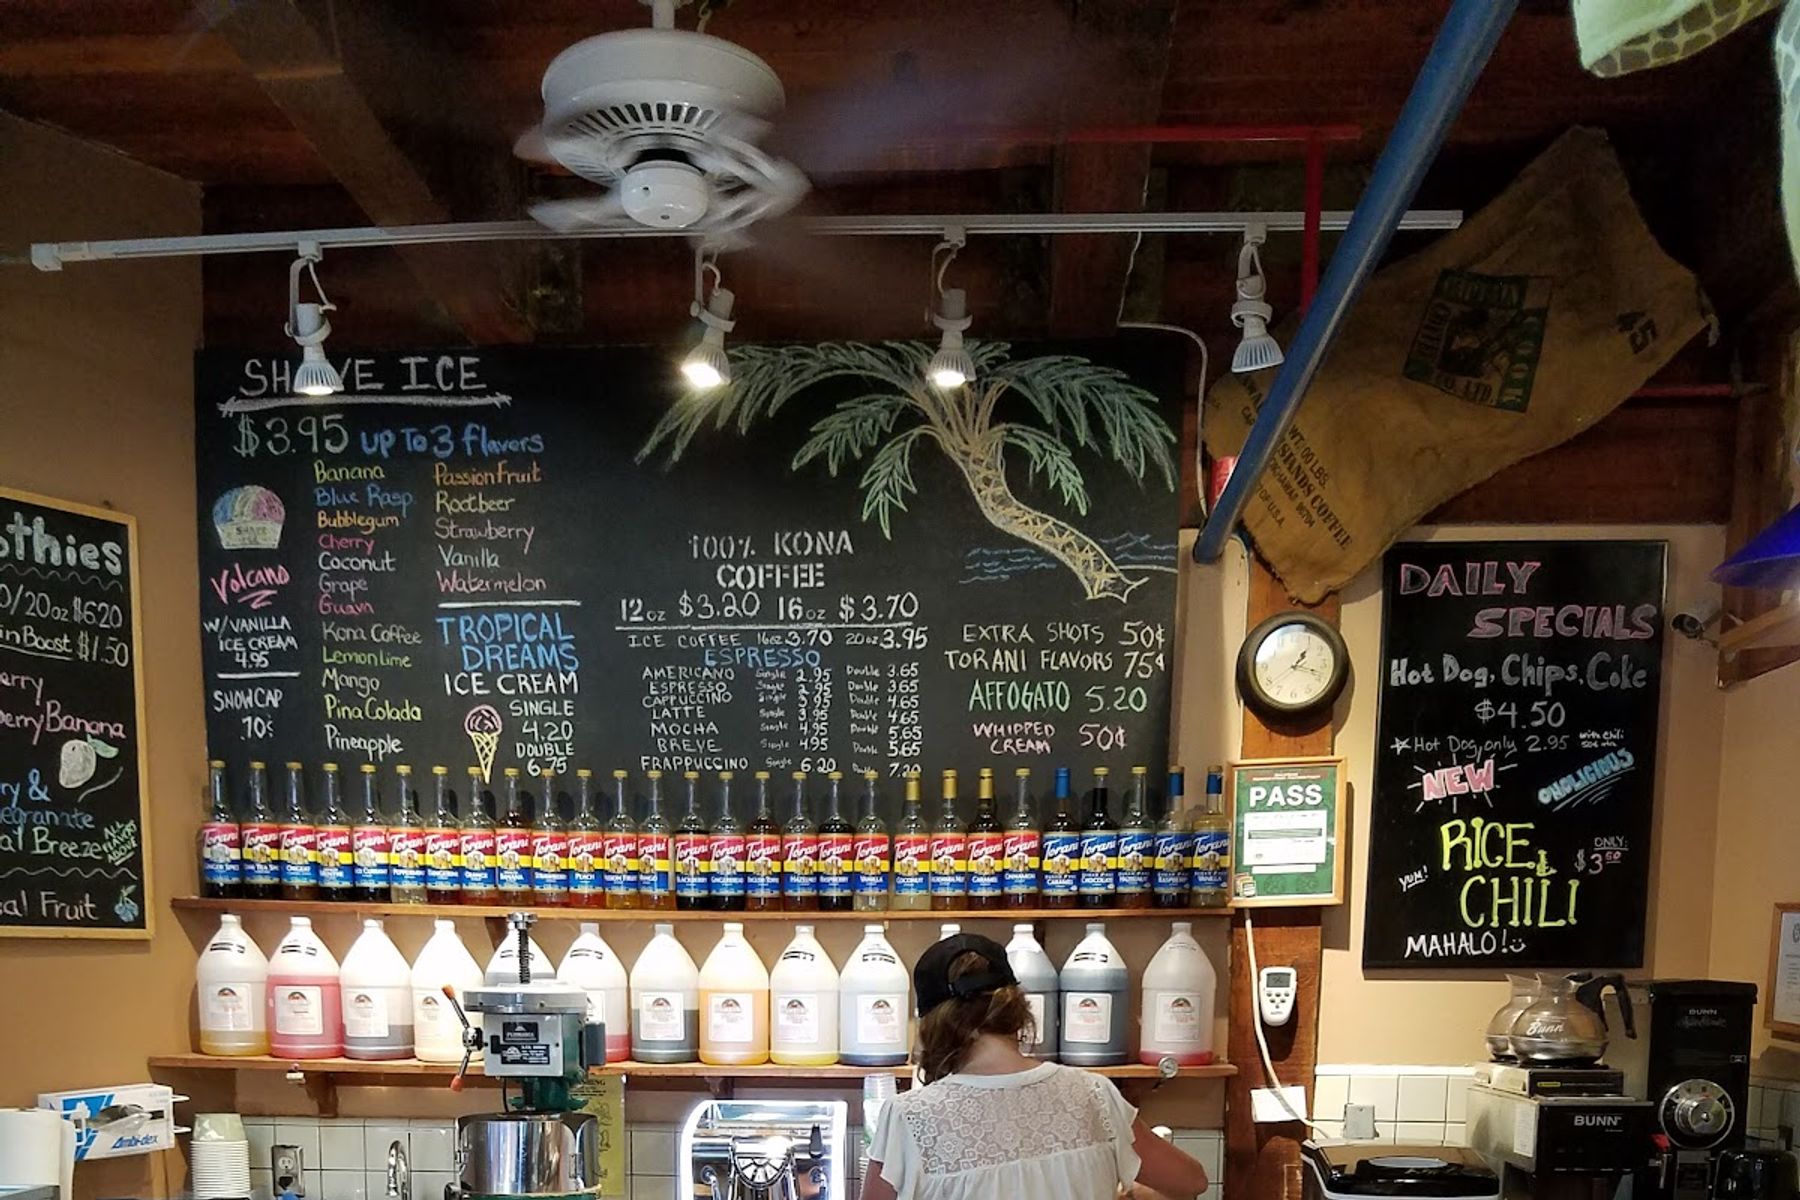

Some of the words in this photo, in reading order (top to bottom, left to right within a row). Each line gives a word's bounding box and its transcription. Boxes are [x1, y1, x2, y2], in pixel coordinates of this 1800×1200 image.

[239, 357, 384, 396] SHVE
[400, 356, 487, 391] ICE
[233, 413, 349, 458] $3.95
[430, 424, 454, 458] 3
[314, 459, 385, 484] Banana
[315, 486, 359, 507] Blue
[367, 483, 414, 519] Rasp
[1278, 438, 1315, 497] SLANDS
[1310, 494, 1353, 550] COFFEE
[317, 510, 400, 535] Bubblegum
[319, 533, 375, 556] Cherry
[435, 516, 535, 555] Strawberry
[688, 533, 756, 559] 100%
[775, 530, 853, 556] KONA
[319, 550, 397, 571] Coconut
[438, 544, 500, 568] Vanilla
[211, 562, 290, 604] Volcano
[319, 572, 369, 602] Grape
[436, 569, 547, 594] Watermelon
[716, 563, 825, 590] COFFEE
[1400, 561, 1541, 597] DAILY
[319, 594, 375, 615] Guava
[621, 598, 644, 622] 12
[679, 588, 761, 619] $3.20
[778, 595, 803, 621] 16
[839, 591, 919, 623] $3.70
[322, 621, 367, 641] Kona
[371, 623, 422, 645] Coffee
[435, 612, 575, 645] TROPICAL
[962, 623, 1035, 644] EXTRA
[1047, 622, 1104, 644] SHOTS
[1467, 604, 1657, 639] SPECIALS
[22, 625, 73, 653] Boost
[219, 638, 246, 651] ICE
[248, 634, 298, 650] CREAM
[628, 634, 666, 648] ICE
[677, 632, 742, 648] COFFEE
[785, 629, 833, 646] 3.70
[879, 626, 928, 649] 3.95
[235, 651, 269, 668] 4.95
[461, 643, 579, 672] DREAMS
[704, 647, 821, 668] ESPRESSO
[944, 648, 1027, 673] TORANI
[1040, 649, 1113, 672] FLAVORS
[322, 667, 380, 698] Mango
[444, 672, 491, 696] ICE
[496, 671, 579, 695] CREAM
[642, 665, 735, 680] AMERICANO
[1390, 657, 1435, 687] Hot
[1587, 651, 1647, 691] Coke
[642, 690, 733, 708] CAPPUCCINO
[649, 681, 727, 695] ESPRESSO
[968, 678, 1071, 713] AFFOGATO
[1085, 685, 1148, 713] 5.20
[46, 700, 126, 738] Banana
[509, 699, 574, 716] SINGLE
[652, 705, 706, 719] LATTE
[1474, 698, 1566, 729] $4.50
[522, 720, 574, 742] 4.20
[651, 721, 719, 737] MOCHA
[972, 721, 1055, 738] WHIPPED
[324, 724, 404, 762] Pineapple
[516, 742, 574, 758] DOUBLE
[657, 738, 722, 753] BREVE
[990, 738, 1051, 755] CREAM
[1414, 737, 1440, 751] Hot
[1525, 735, 1570, 752] 2.95
[640, 756, 748, 771] FRAPPUCCINO
[28, 768, 52, 801] &
[1422, 759, 1495, 801] NEW
[1249, 784, 1322, 808] PASS
[32, 826, 103, 859] Breeze
[895, 839, 928, 865] Torani
[931, 839, 965, 862] Torani
[1003, 836, 1038, 858] Torani
[1044, 838, 1079, 860] Torani
[1081, 837, 1116, 860] Torani
[1440, 817, 1536, 871] RICE
[40, 890, 99, 920] Fruit
[1460, 874, 1580, 928] CHILI
[1574, 1115, 1622, 1127] BUNN
